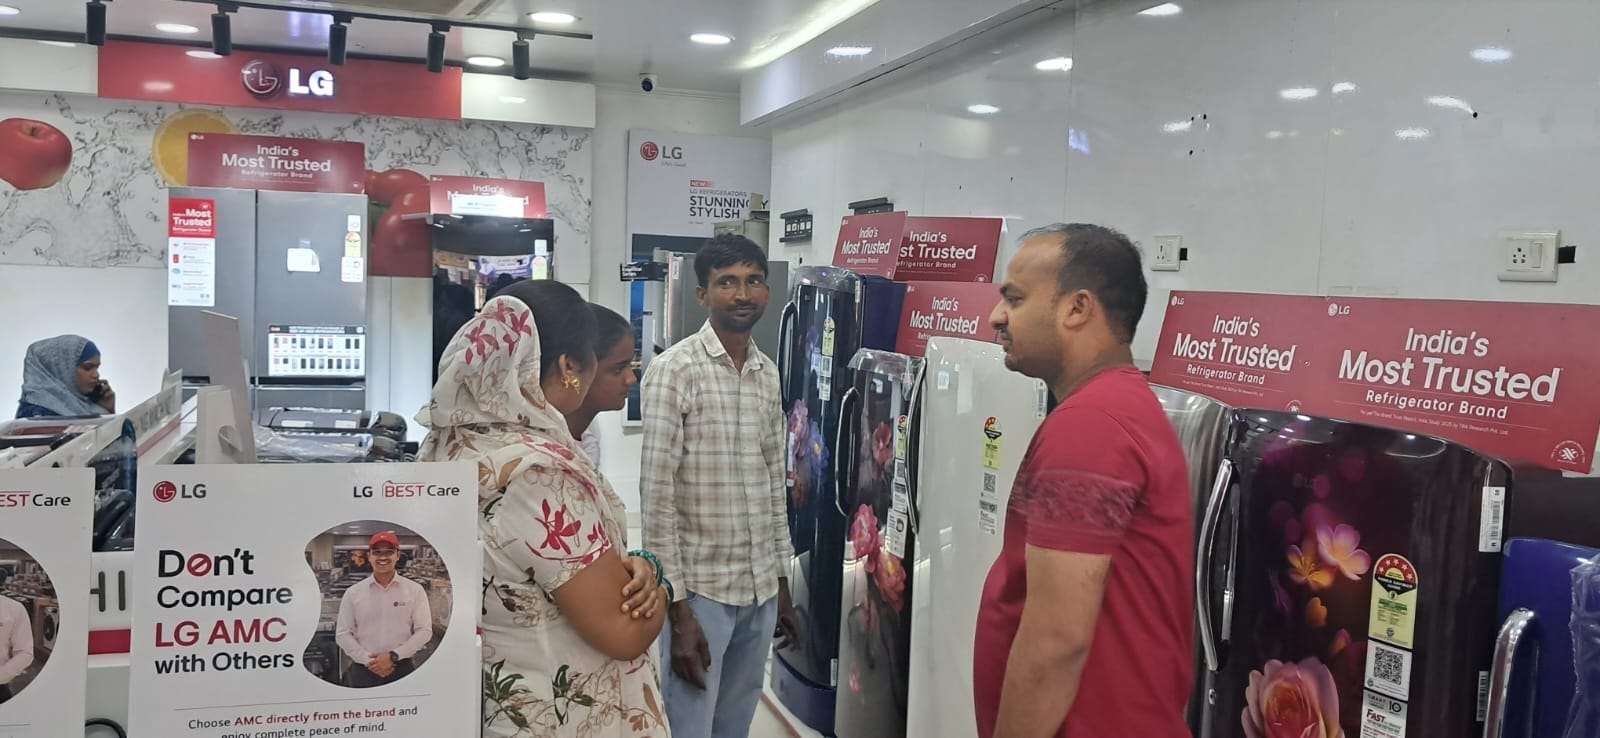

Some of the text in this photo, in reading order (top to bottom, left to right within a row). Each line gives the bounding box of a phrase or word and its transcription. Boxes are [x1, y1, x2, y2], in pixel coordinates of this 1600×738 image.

[289, 68, 334, 96] LG
[257, 145, 299, 156] India's
[662, 146, 682, 160] LG
[222, 153, 331, 172] Most Trusted
[241, 169, 313, 179] Refrigerator Brand
[473, 184, 505, 194] India's
[699, 189, 748, 197] REFRIGERATORS
[689, 195, 769, 210] STUNNINY
[185, 209, 212, 218] Most
[689, 207, 740, 219] STYLISH
[173, 217, 212, 227] Trusted
[859, 227, 879, 239] India's
[909, 231, 947, 243] India's
[841, 239, 892, 255] Most Trusted
[900, 244, 977, 260] st Trusted
[896, 260, 957, 269] efrigerator Brand
[932, 296, 959, 311] India's
[1338, 306, 1350, 315] LG
[909, 310, 980, 335] Most Trusted
[1212, 315, 1260, 337] India's
[1405, 328, 1490, 357] India's
[1172, 333, 1297, 371] Most Trusted
[1186, 364, 1265, 385] Refrigerator Brand
[1338, 350, 1561, 402] Most Trusted
[1366, 390, 1508, 419] Refrigerator Brand
[182, 484, 206, 498] LG
[354, 484, 460, 498] LG BEST Care
[32, 494, 71, 507] Care
[158, 548, 254, 578] Don't
[157, 586, 293, 611] Compare
[155, 617, 288, 648] LG AMC
[154, 651, 295, 674] with Others
[188, 706, 418, 729] Choose AMC directly from the brand and
[254, 728, 305, 738] complete
[309, 727, 340, 738] peace
[343, 723, 356, 734] of
[358, 722, 387, 733] mind.
